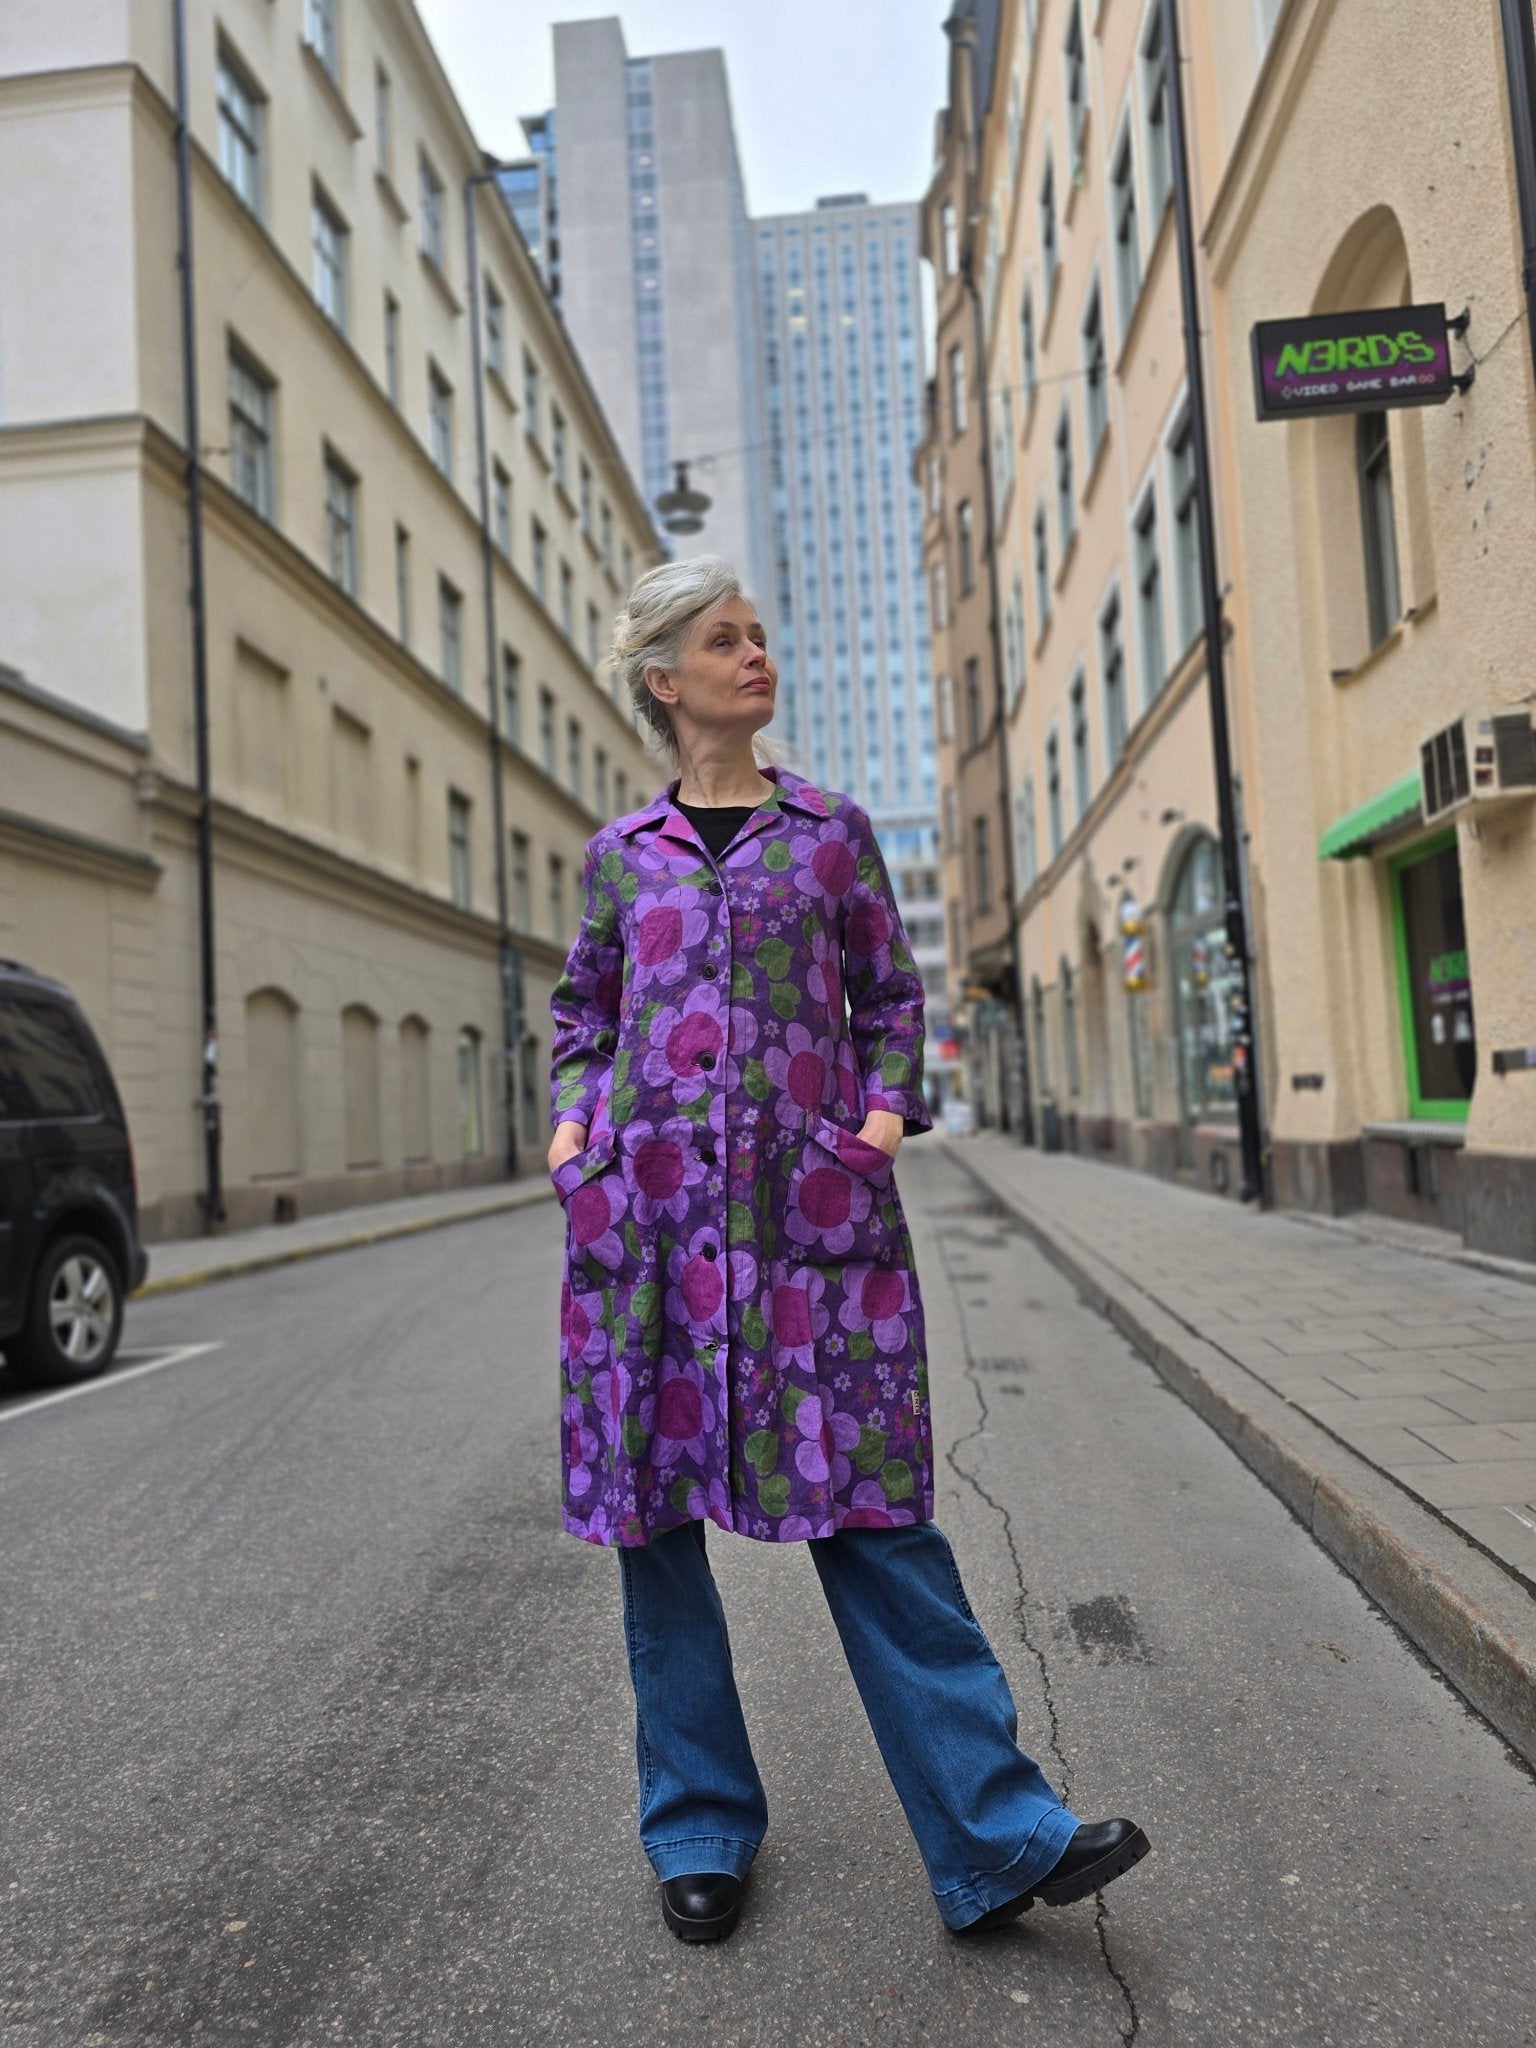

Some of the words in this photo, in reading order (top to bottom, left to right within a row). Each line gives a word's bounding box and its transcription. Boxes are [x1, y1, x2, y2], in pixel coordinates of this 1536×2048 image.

[1294, 383, 1338, 396] VIDEO
[1346, 378, 1382, 391] GAME
[1389, 373, 1417, 387] BAR
